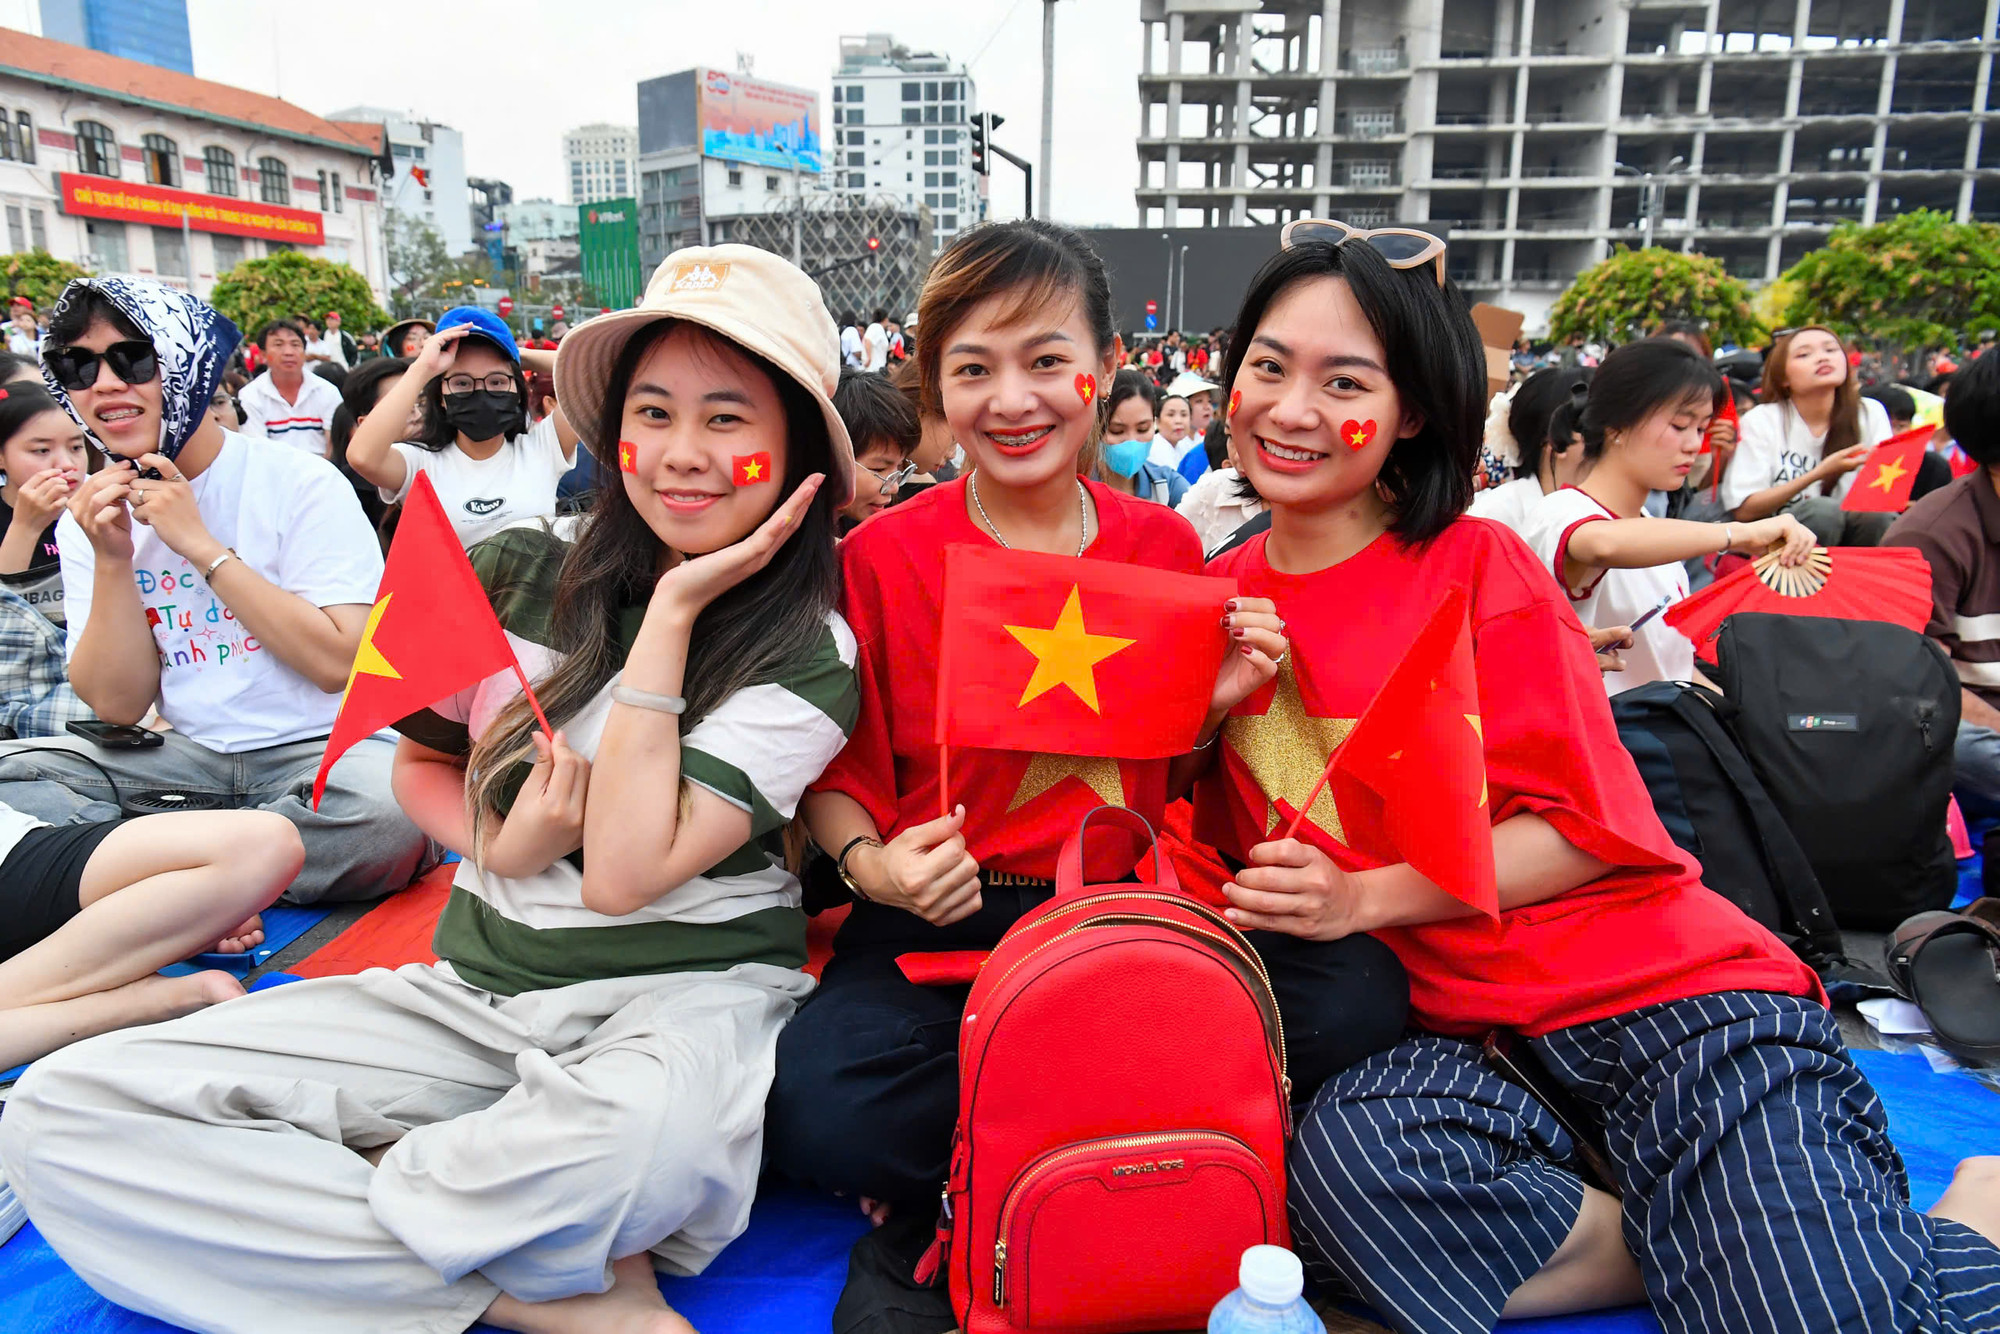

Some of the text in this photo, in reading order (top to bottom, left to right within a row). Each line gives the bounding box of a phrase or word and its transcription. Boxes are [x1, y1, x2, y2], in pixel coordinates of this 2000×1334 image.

[1780, 450, 1817, 473] YOU
[135, 569, 194, 595] Độc
[158, 604, 193, 632] Tự
[1112, 1159, 1186, 1177] MICHAEL KORS
